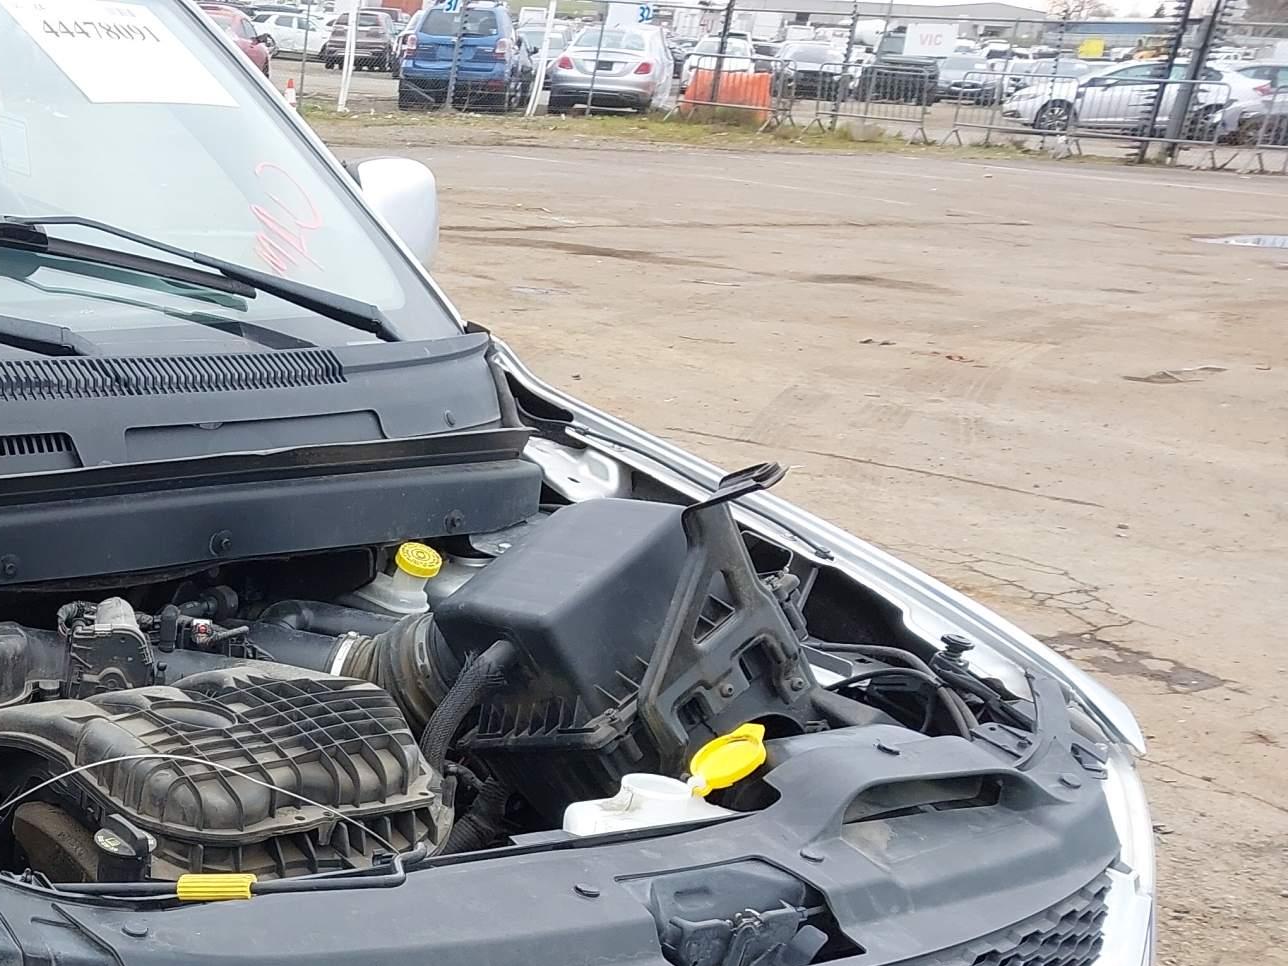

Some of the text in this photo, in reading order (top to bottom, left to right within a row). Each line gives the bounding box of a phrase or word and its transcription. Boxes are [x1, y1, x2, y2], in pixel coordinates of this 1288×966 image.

[638, 6, 653, 23] 32
[42, 19, 161, 43] 44478091
[919, 32, 943, 47] VIC
